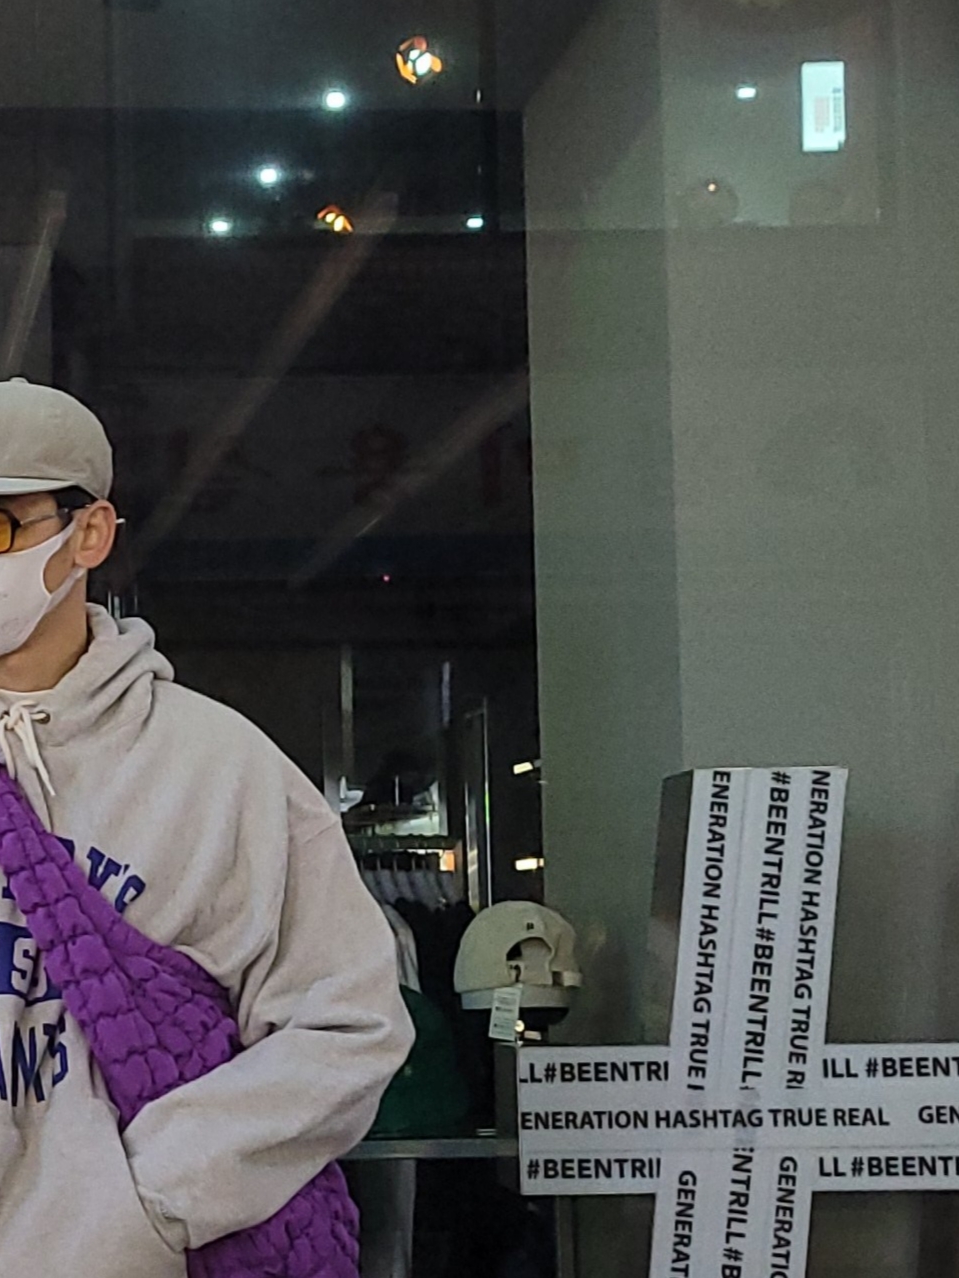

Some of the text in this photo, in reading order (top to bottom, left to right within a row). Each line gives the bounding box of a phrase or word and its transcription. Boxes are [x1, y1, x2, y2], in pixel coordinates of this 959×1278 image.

[693, 904, 720, 1013] HASHTAG
[794, 891, 821, 999] HASHTAG
[687, 1019, 710, 1079] TRUE
[788, 1005, 811, 1065] TRUE
[521, 1110, 648, 1130] ENERATION
[655, 1109, 763, 1129] HASHTAG
[768, 1107, 828, 1128] TRUE
[833, 1107, 890, 1127] REAL
[725, 1147, 755, 1244] NTRILL
[851, 1156, 959, 1177] #BEENT
